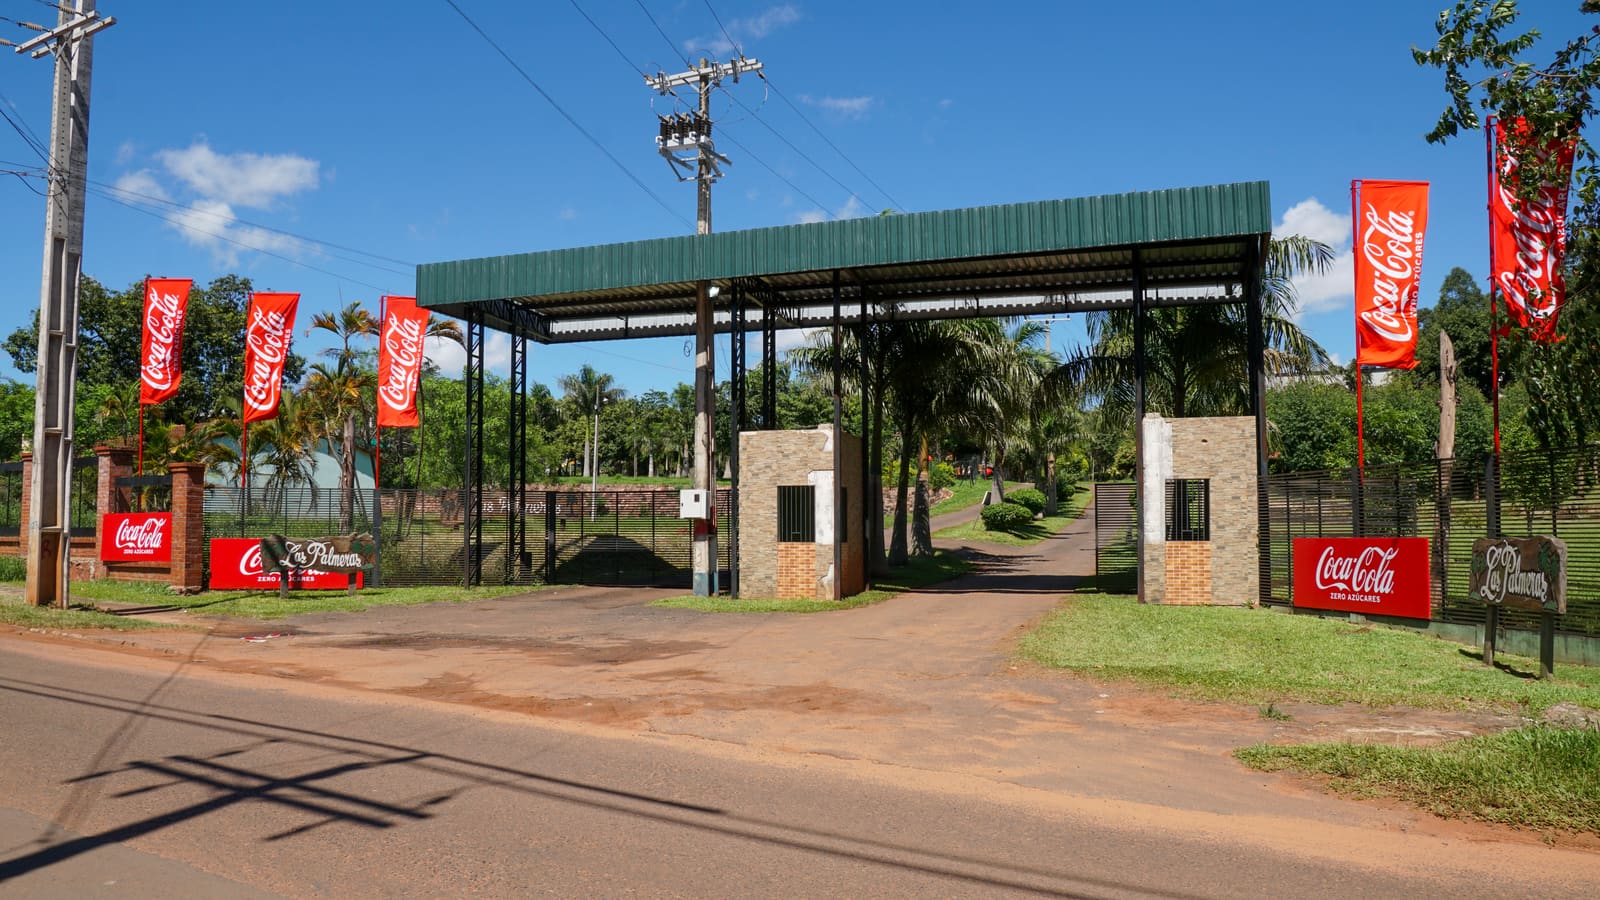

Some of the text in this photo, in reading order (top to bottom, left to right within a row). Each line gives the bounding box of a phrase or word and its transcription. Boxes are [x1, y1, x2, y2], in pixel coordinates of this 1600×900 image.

[1413, 232, 1423, 287] AZÚCARES
[1500, 145, 1558, 318] Coca-Co
[1361, 202, 1413, 341] Coca-Cola
[141, 288, 178, 390] Coca-Cola
[244, 305, 285, 410] Coca-Cola
[379, 312, 420, 410] Coca-Cola
[116, 518, 167, 548] Coca-Cola
[279, 541, 307, 568] Las
[300, 540, 361, 568] Palmeras
[1316, 545, 1399, 594] Coca-Cola
[1330, 592, 1381, 603] ZERO AZÚCARES
[1480, 540, 1548, 602] Las Palmeras
